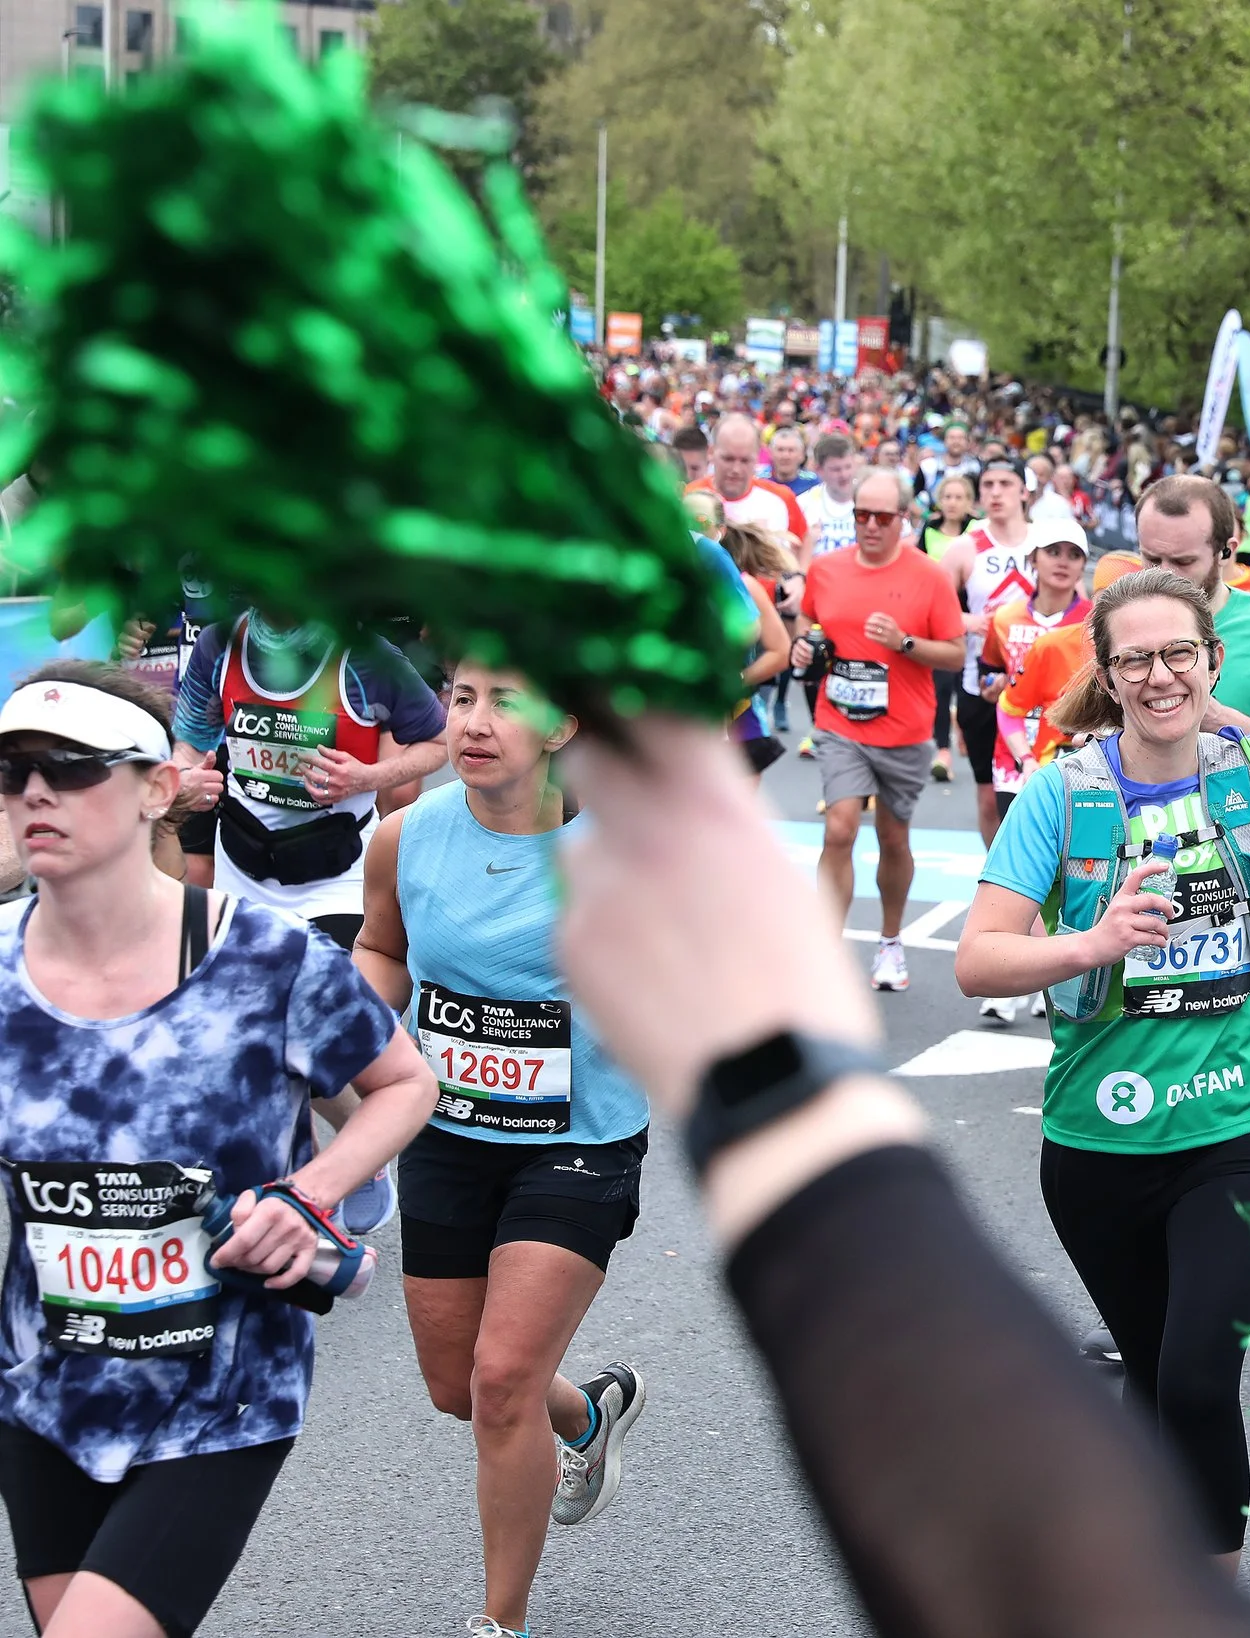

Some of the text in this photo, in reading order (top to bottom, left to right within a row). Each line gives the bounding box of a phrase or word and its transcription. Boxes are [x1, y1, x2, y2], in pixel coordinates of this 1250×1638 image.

[185, 620, 201, 643] tc
[233, 708, 272, 736] tcs
[276, 713, 298, 723] TATA
[274, 731, 309, 741] SERVICES
[275, 722, 330, 735] CONSULTANCY
[246, 747, 314, 777] 1842
[269, 795, 285, 805] new
[1188, 879, 1221, 892] TATA
[1190, 887, 1238, 904] CONSULTA
[428, 990, 476, 1034] tcs
[481, 1004, 515, 1017] TATA
[1185, 1000, 1211, 1011] new
[481, 1016, 562, 1029] CONSULTANCY
[482, 1026, 532, 1039] SERVICES
[440, 1047, 545, 1091] 12697
[1165, 1064, 1245, 1107] OXFAM
[475, 1113, 557, 1129] new balance
[95, 1172, 142, 1186] TATA
[21, 1171, 93, 1217] tcs
[98, 1182, 203, 1201] CONSULTANCY
[101, 1202, 167, 1218] SERVICES
[57, 1236, 190, 1295] 10408
[107, 1325, 215, 1351] new balance
